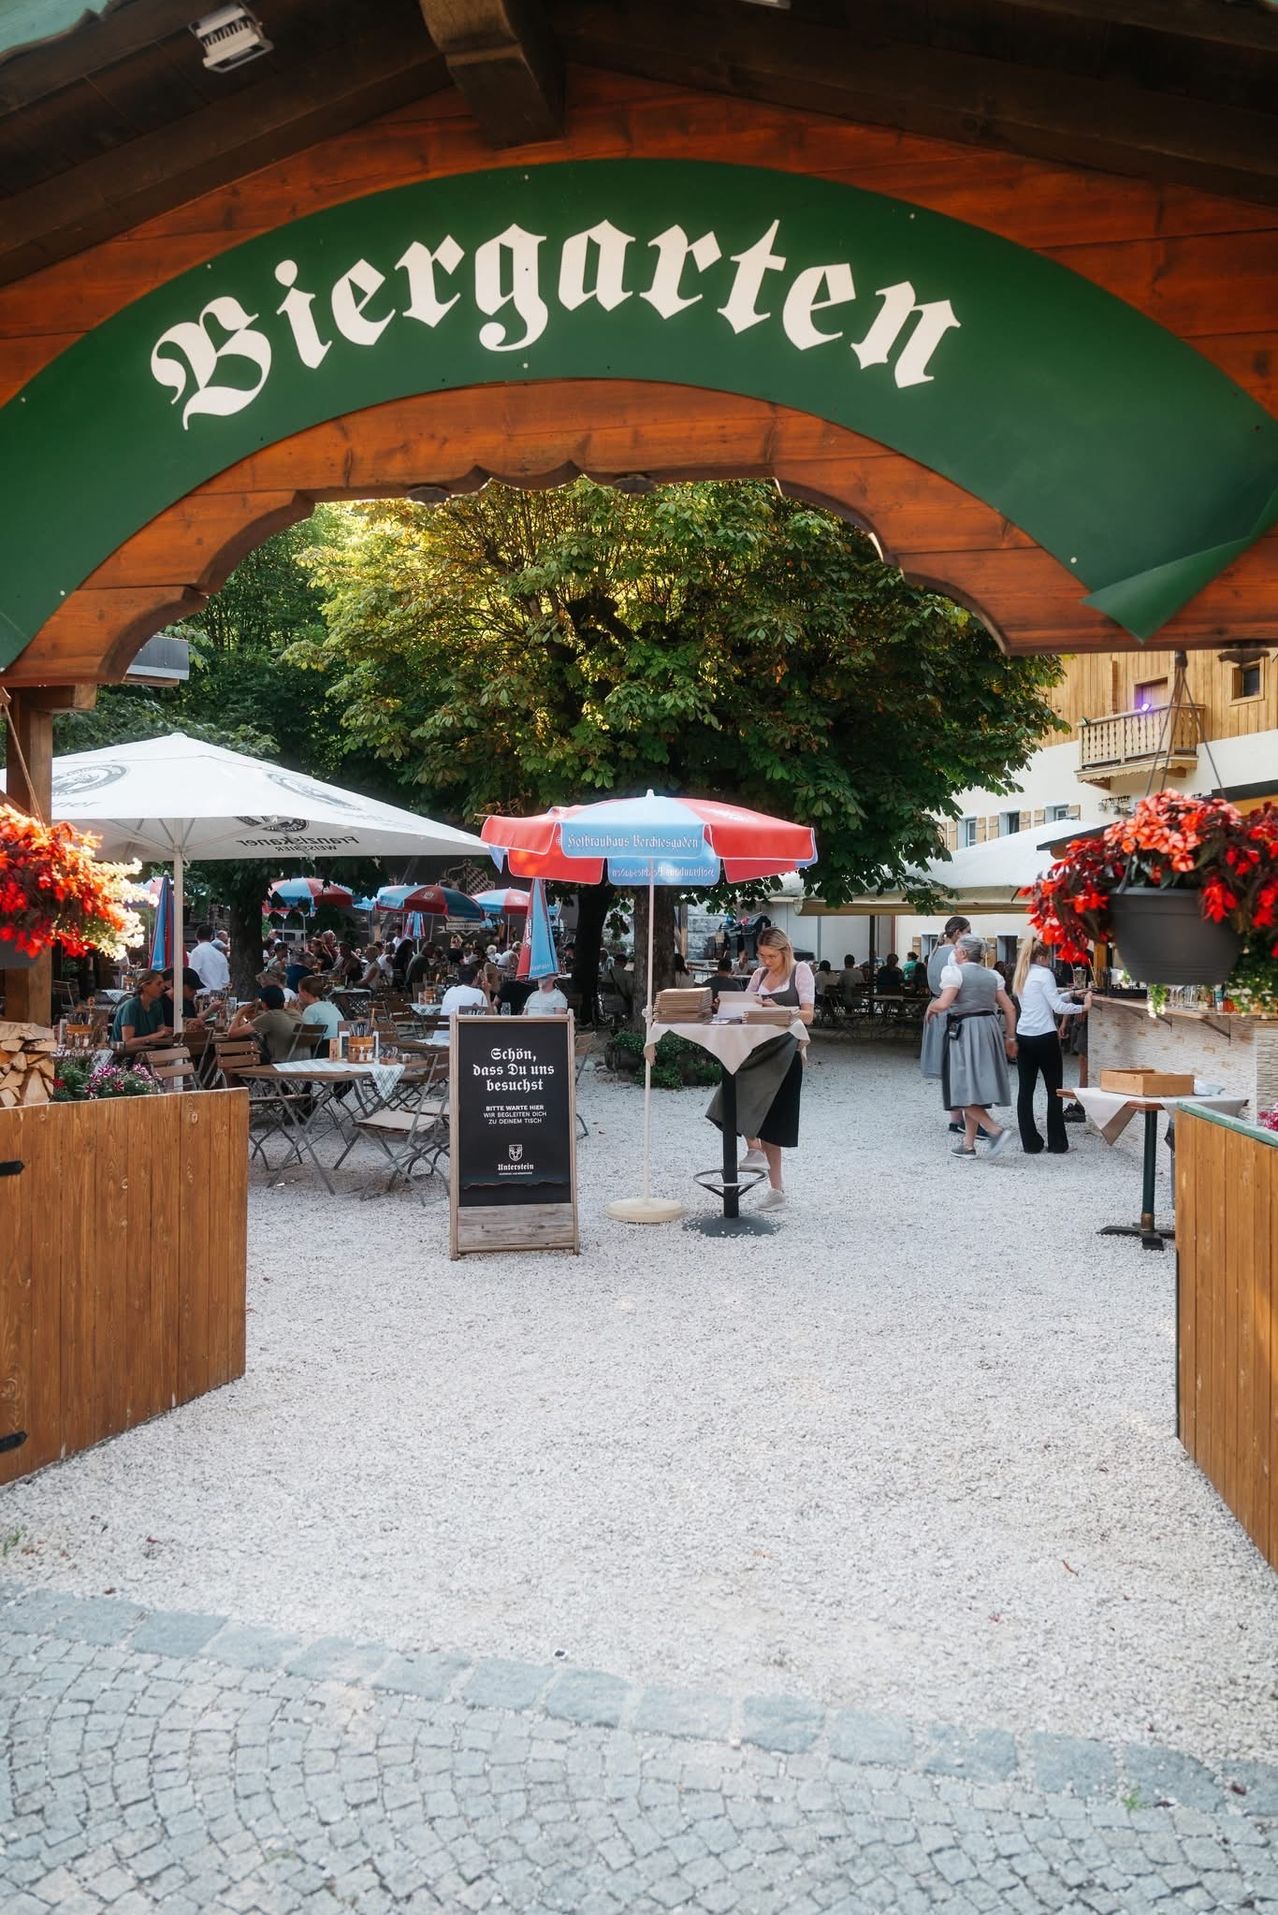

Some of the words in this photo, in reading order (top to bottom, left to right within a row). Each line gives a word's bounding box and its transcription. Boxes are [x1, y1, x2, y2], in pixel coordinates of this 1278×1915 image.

[151, 219, 962, 431] Biergarten
[632, 834, 699, 850] Berchtesgaden
[490, 1047, 537, 1062] Schön,
[472, 1063, 504, 1076] dass
[507, 1063, 527, 1075] Du
[530, 1065, 555, 1075] uns
[486, 1078, 544, 1094] besuchst
[497, 1162, 535, 1171] Unterstein
